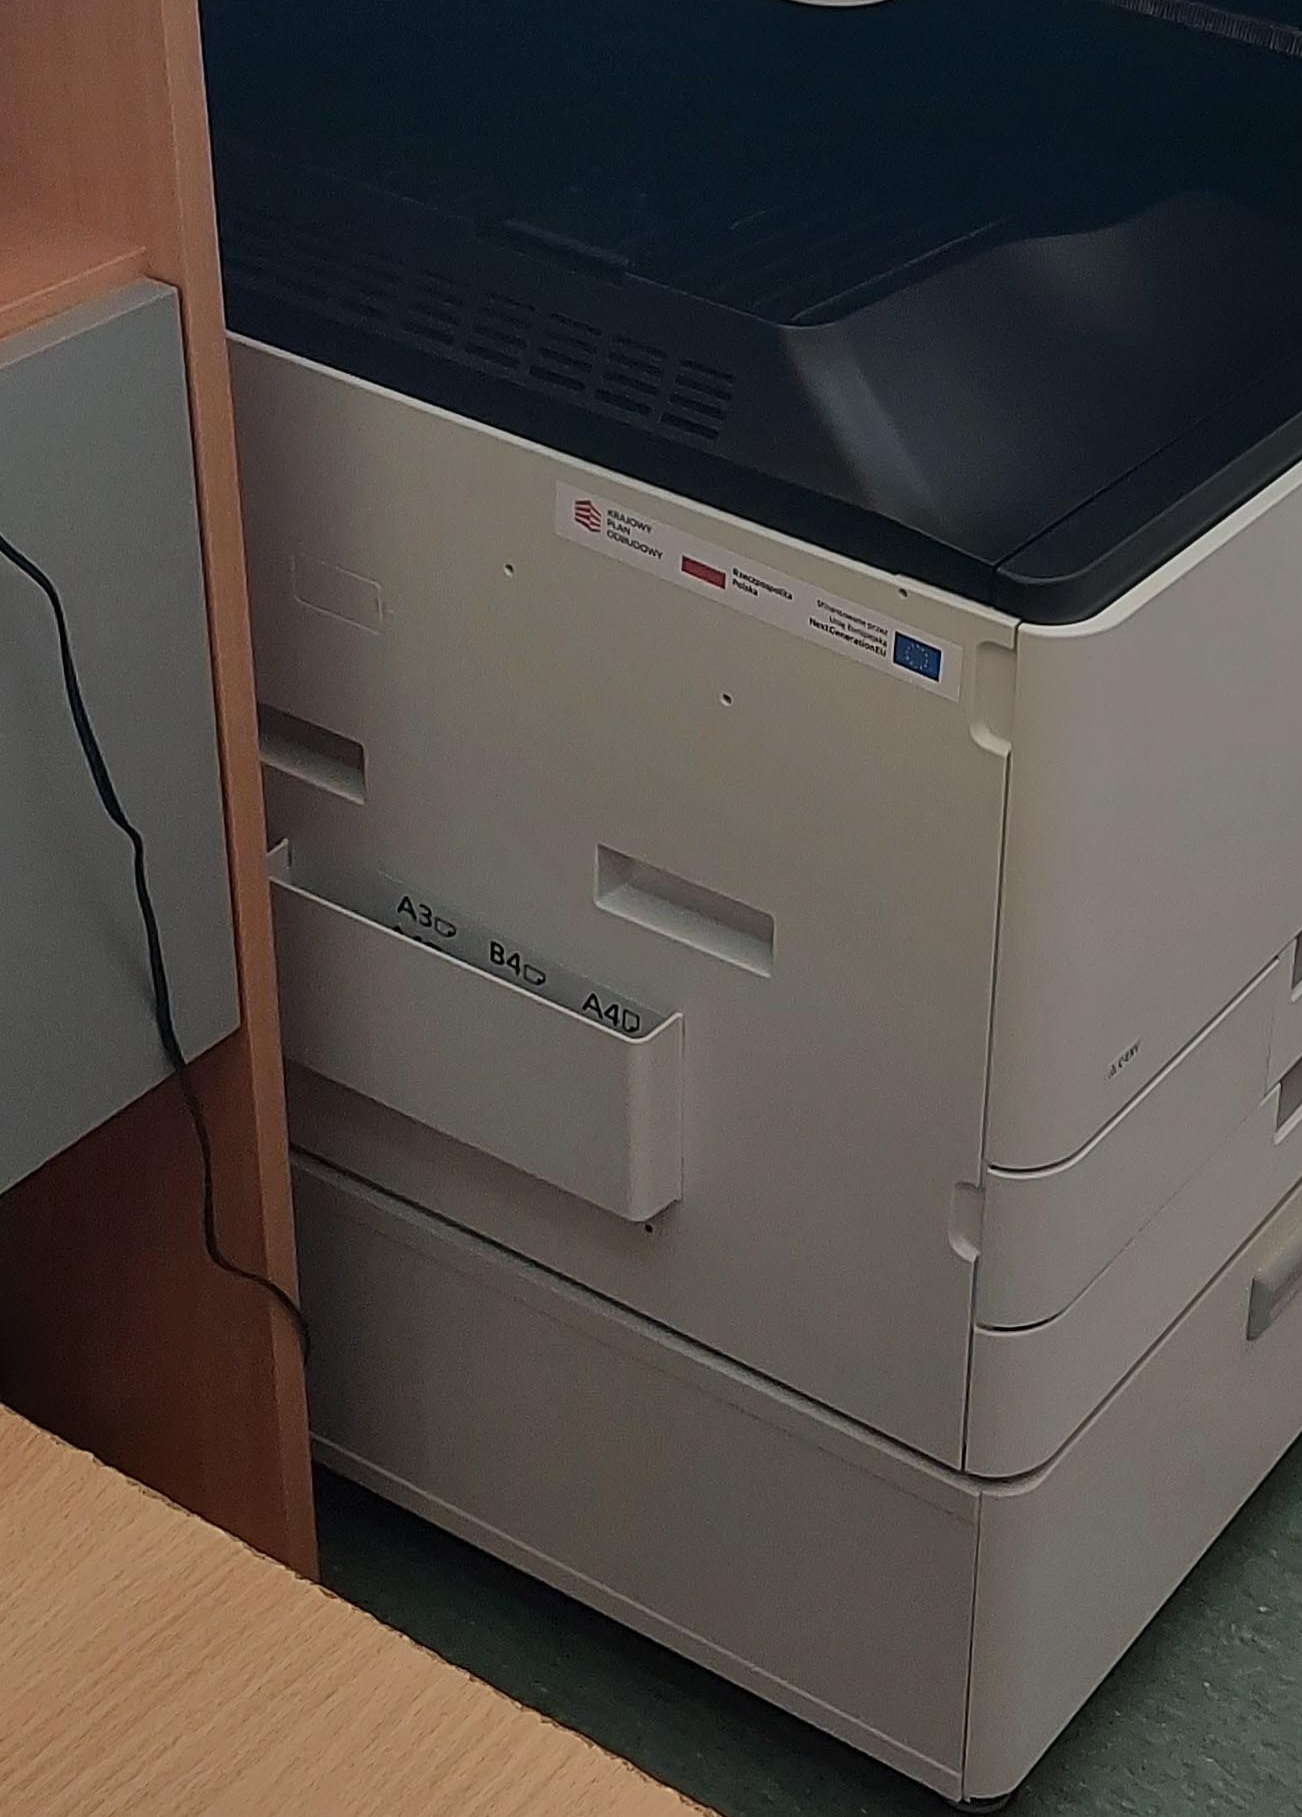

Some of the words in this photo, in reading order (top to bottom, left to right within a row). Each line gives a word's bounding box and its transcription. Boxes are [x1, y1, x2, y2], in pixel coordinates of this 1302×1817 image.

[607, 509, 652, 534] KRAJOWY
[607, 518, 631, 536] PLAN
[606, 530, 664, 560] ODBUDOWY
[732, 567, 793, 600] Rzeczpospolita
[732, 578, 758, 597] Polska
[397, 896, 433, 929] A3
[490, 941, 521, 976] B4
[582, 993, 621, 1028] A4
